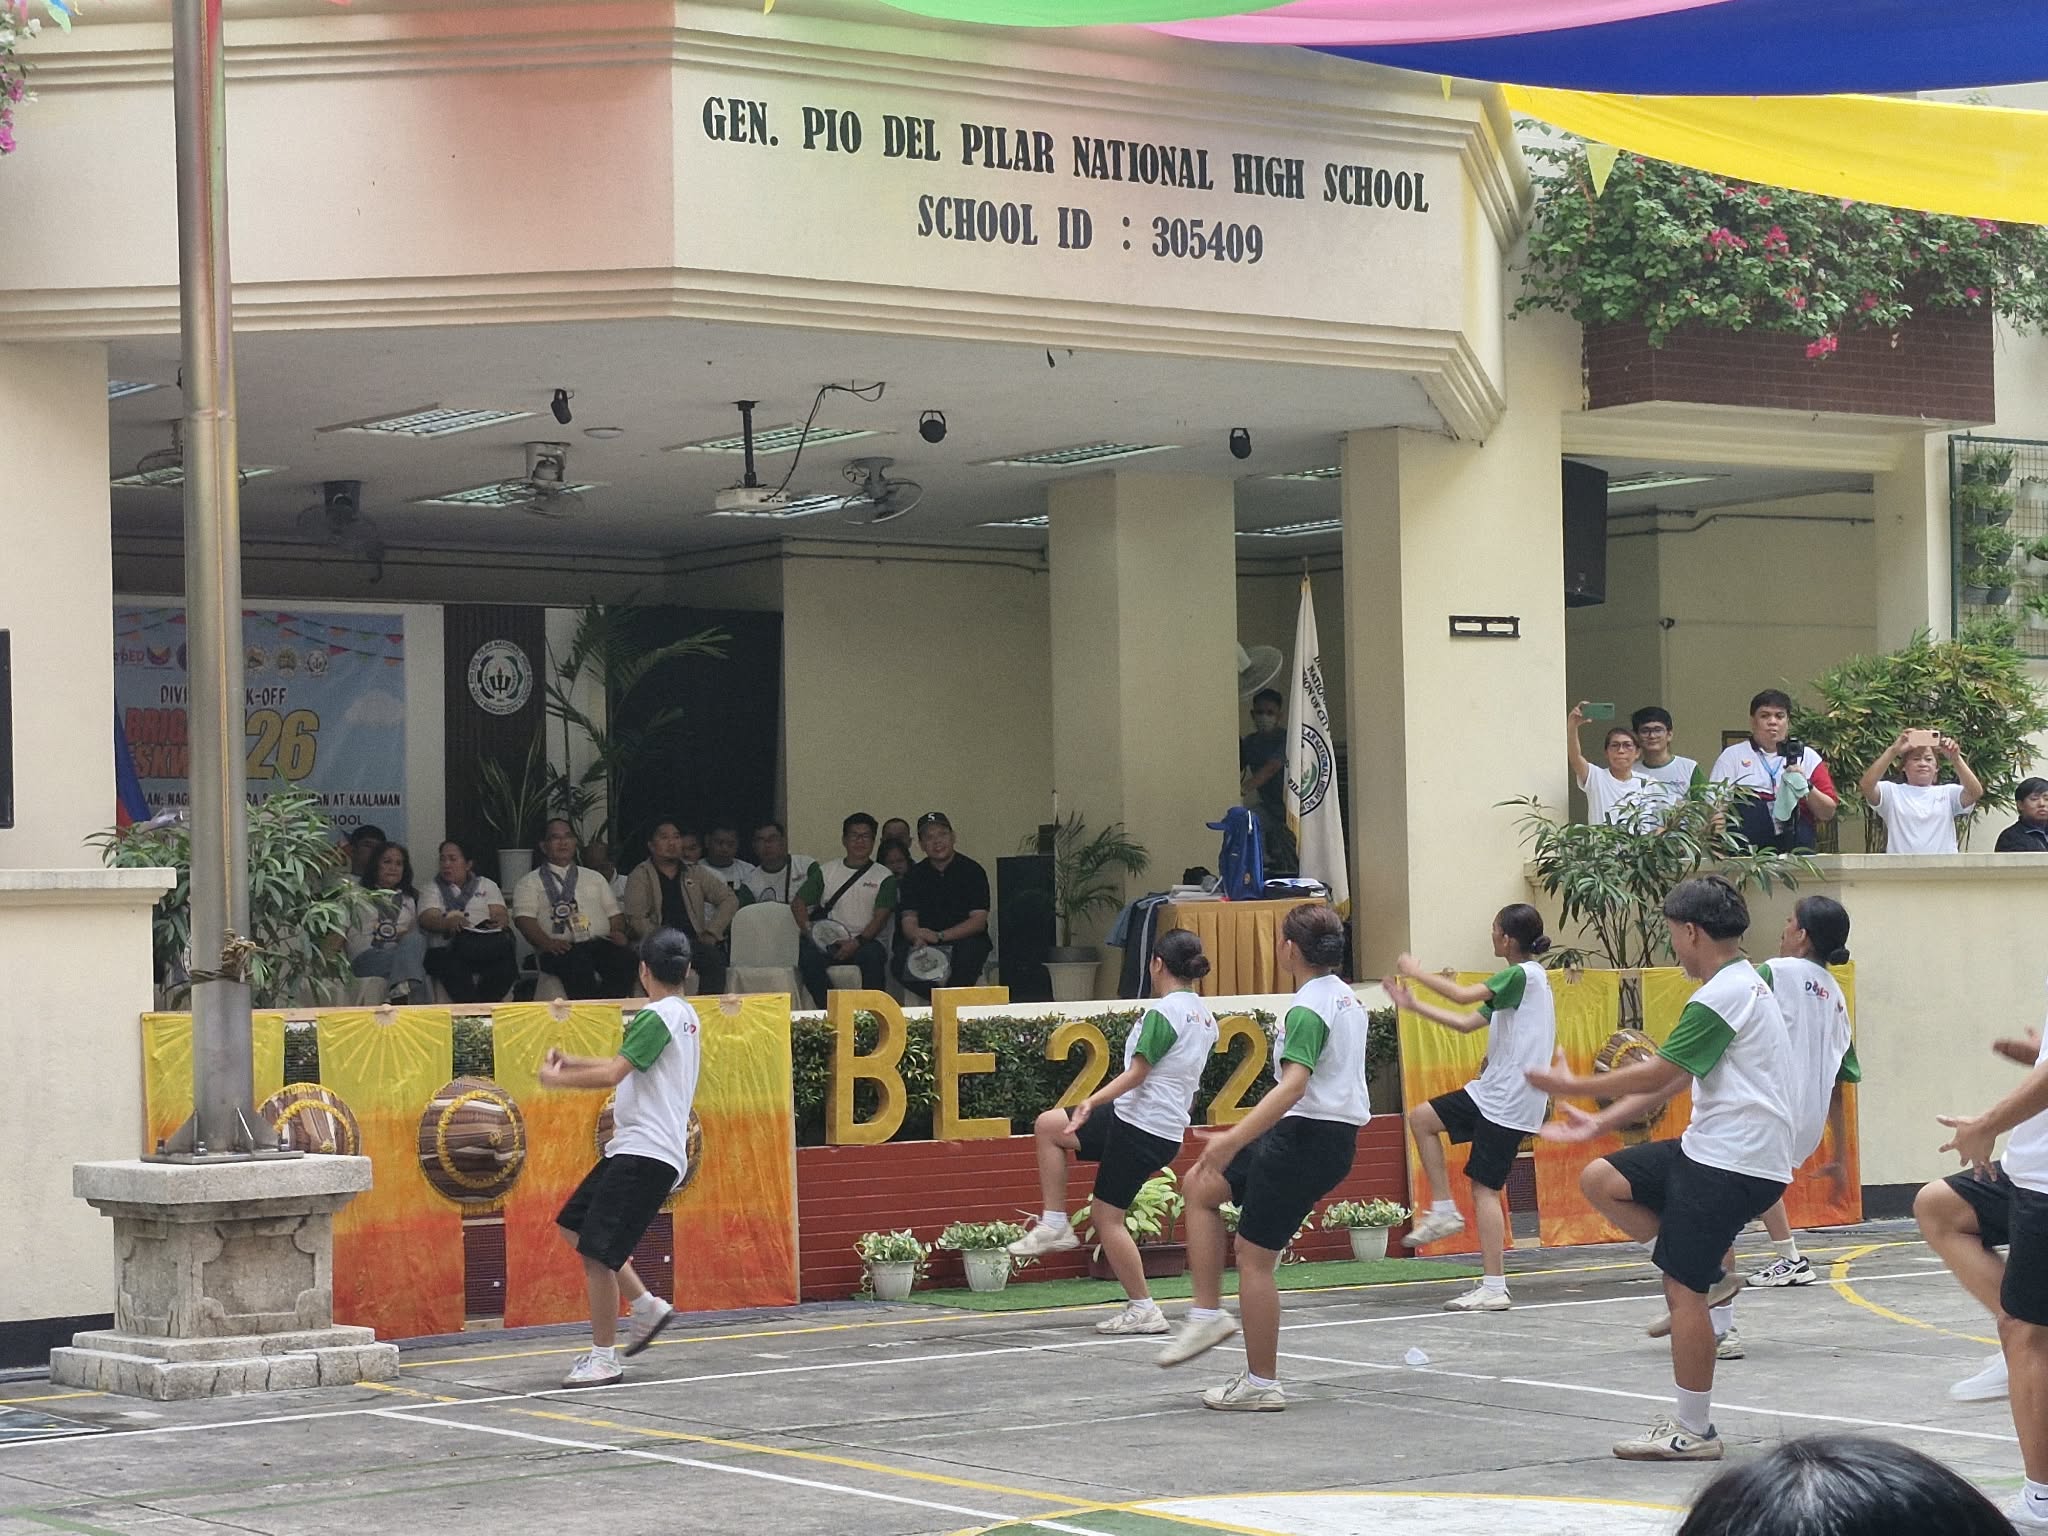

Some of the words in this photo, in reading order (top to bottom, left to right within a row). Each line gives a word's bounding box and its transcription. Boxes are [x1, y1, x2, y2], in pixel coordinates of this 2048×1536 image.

[702, 96, 779, 146] GEN.
[802, 106, 862, 154] PIO
[883, 114, 940, 161] DEL
[961, 123, 1054, 173] PILAR
[1072, 136, 1213, 190] NATIONAL
[1232, 153, 1304, 199] HIGH
[1323, 163, 1429, 212] SCHOOL
[918, 195, 1038, 245] SCHOOL
[1057, 206, 1092, 250] ID
[1151, 216, 1264, 264] 305409
[349, 793, 401, 807] KAALAMAN
